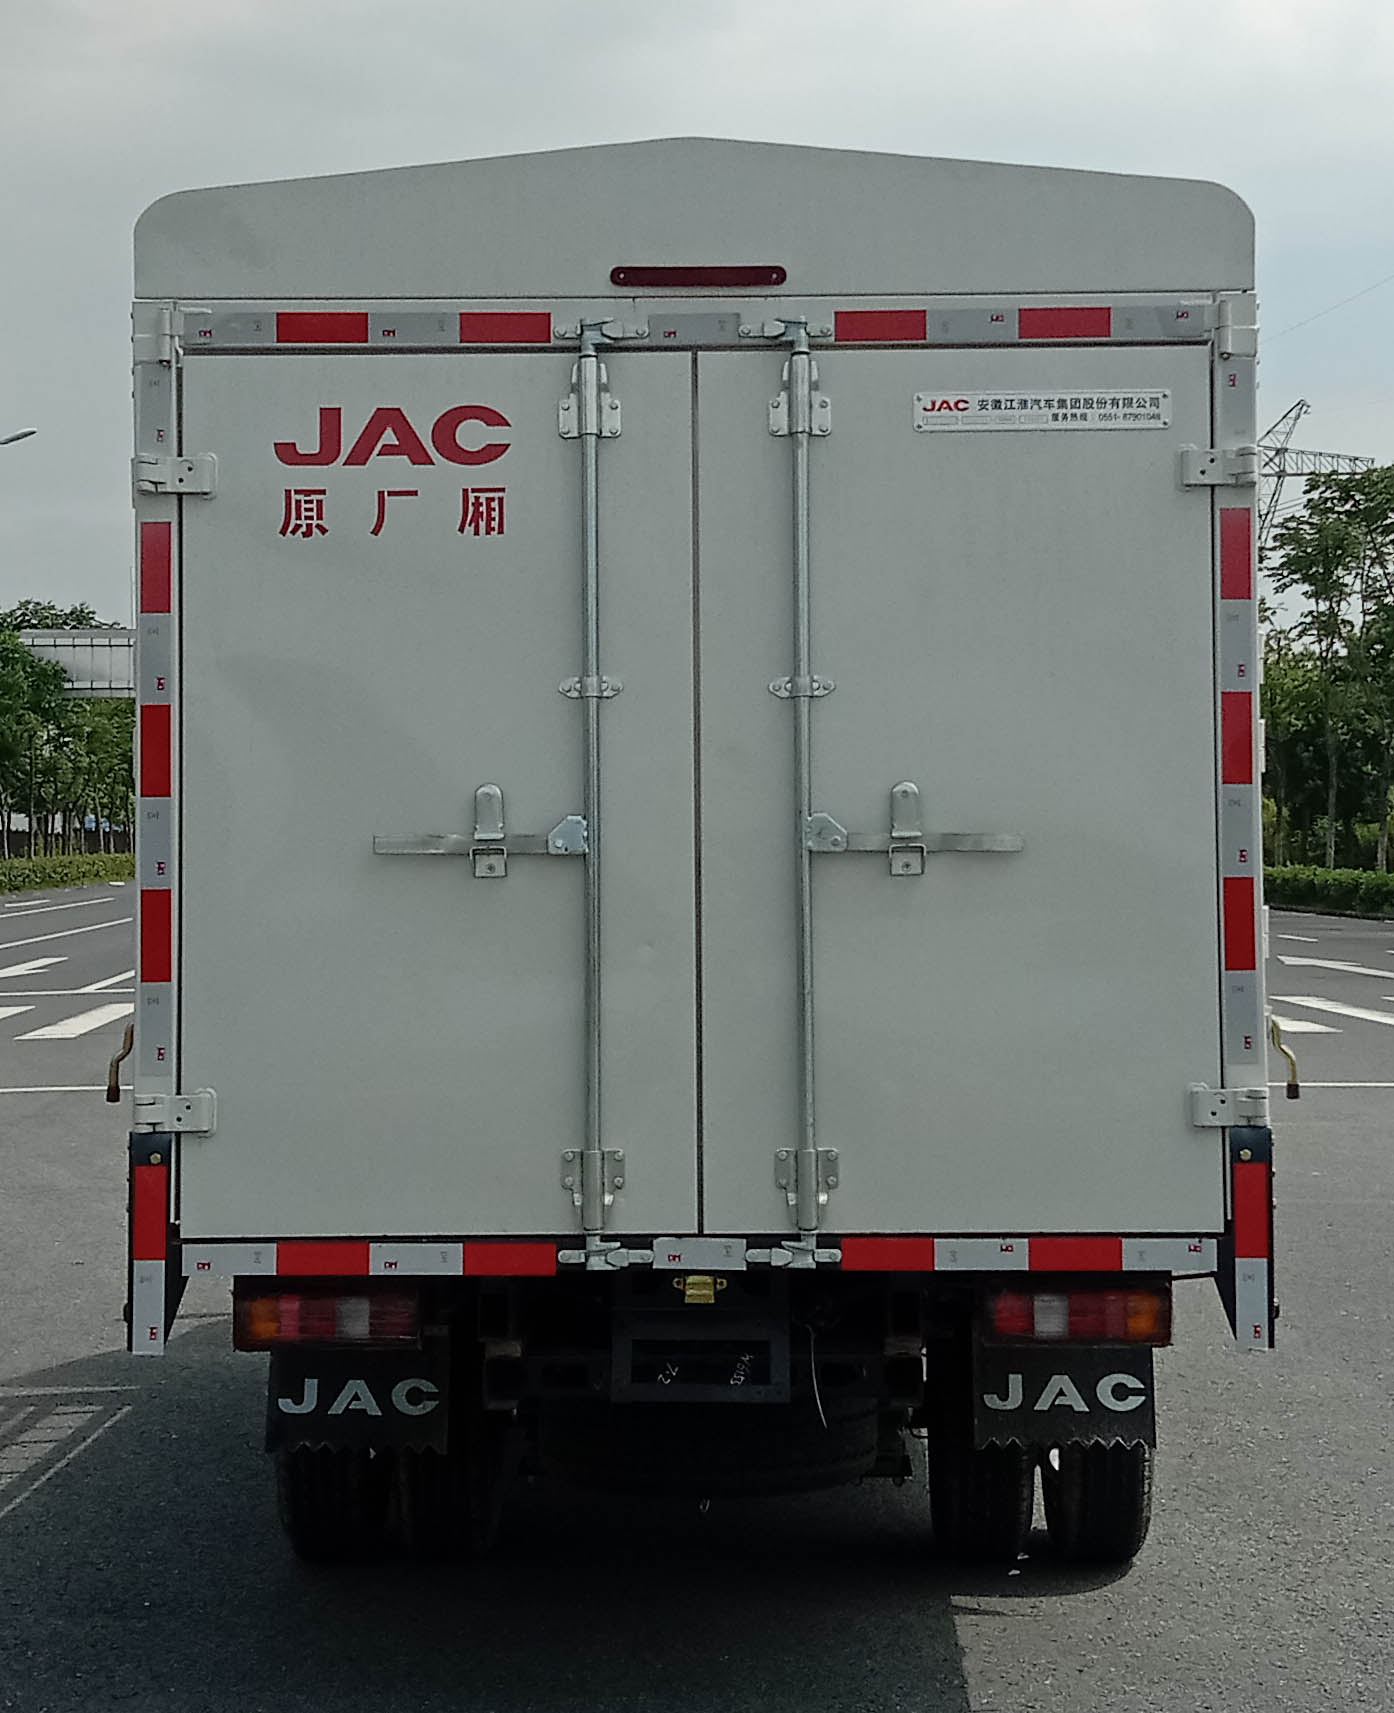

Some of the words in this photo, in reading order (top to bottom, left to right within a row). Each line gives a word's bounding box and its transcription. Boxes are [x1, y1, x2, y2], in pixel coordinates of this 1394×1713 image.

[922, 399, 970, 412] JAC
[977, 396, 1160, 411] 安徽江淮汽车集团股份有限公司
[274, 404, 511, 466] JAC
[277, 1378, 440, 1416] JAC
[983, 1373, 1147, 1412] JAC
